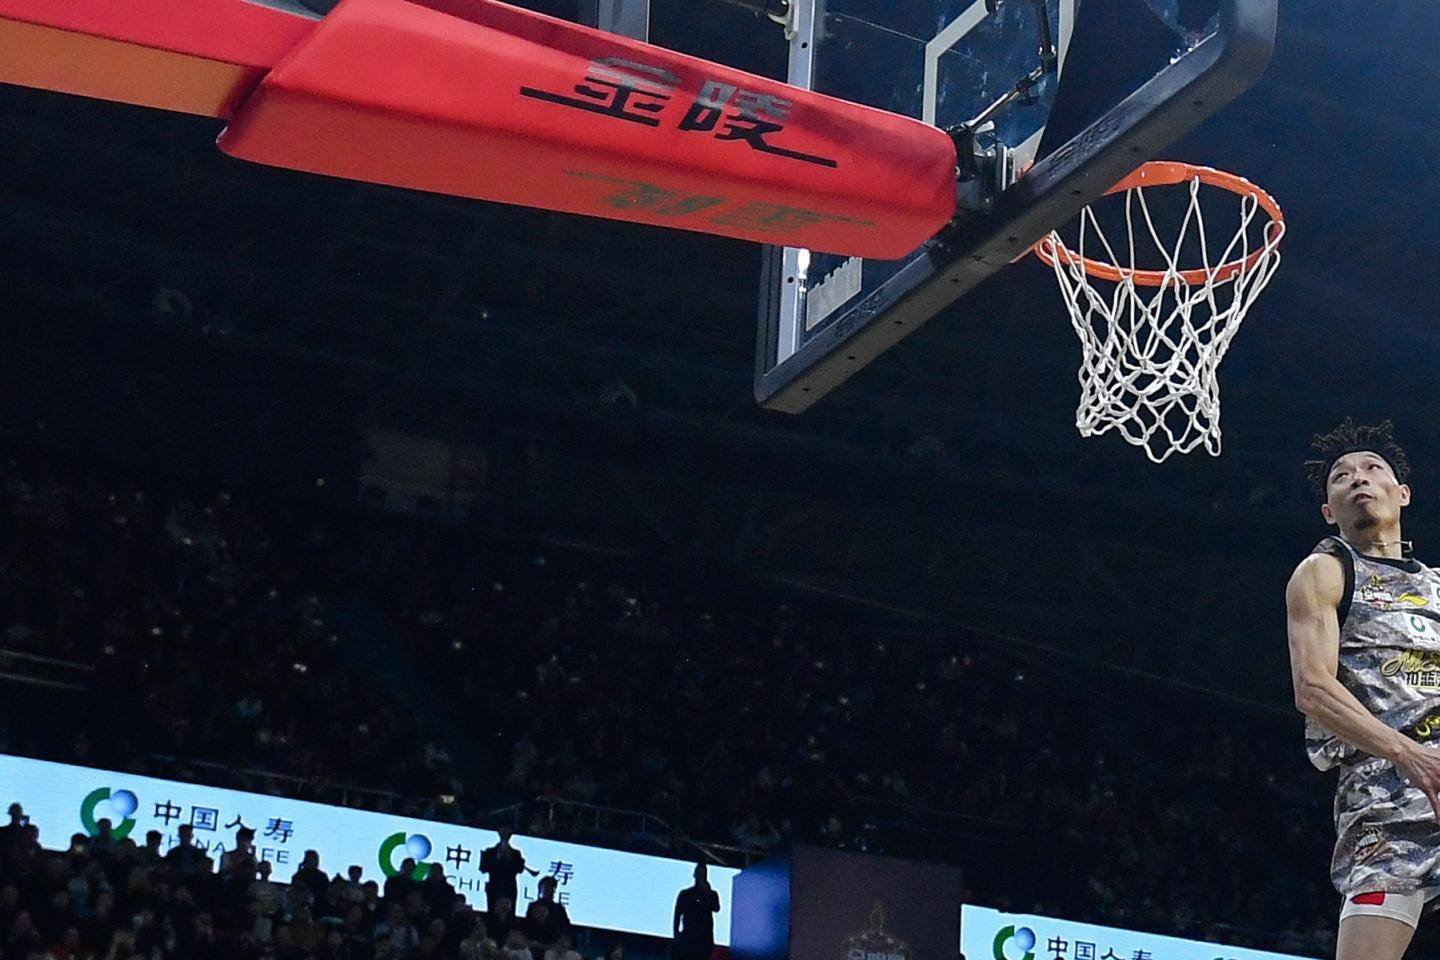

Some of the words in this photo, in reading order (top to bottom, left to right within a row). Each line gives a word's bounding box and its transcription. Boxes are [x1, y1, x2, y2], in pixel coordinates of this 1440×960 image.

[520, 55, 837, 168] 金陵
[154, 799, 293, 844] 中国人寿
[446, 844, 574, 886] 中寿
[524, 887, 570, 905] LE
